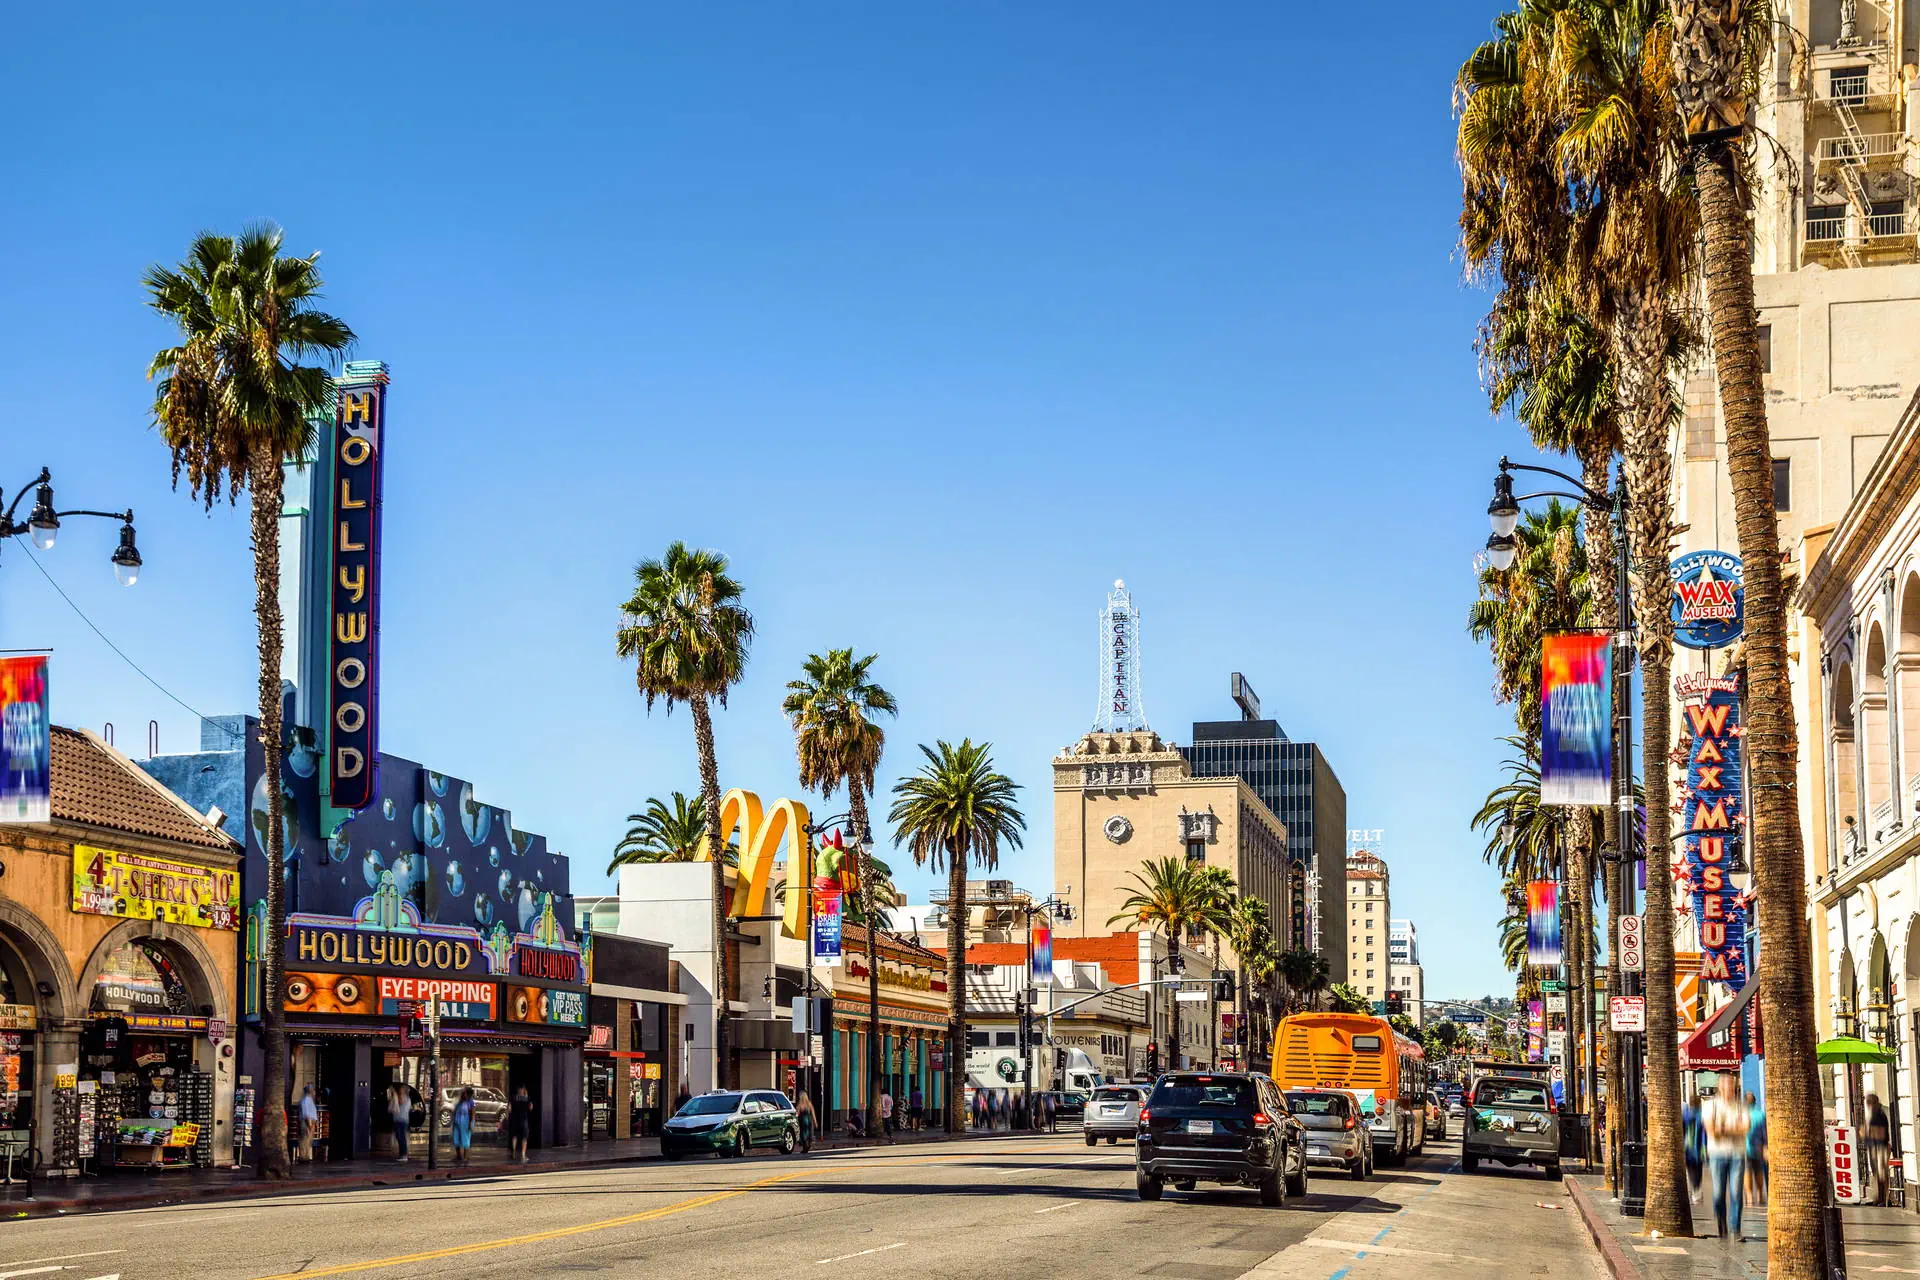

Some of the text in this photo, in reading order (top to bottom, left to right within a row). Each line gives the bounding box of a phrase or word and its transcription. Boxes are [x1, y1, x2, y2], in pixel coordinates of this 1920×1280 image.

[1670, 554, 1744, 583] OLLYWOO
[336, 392, 371, 780] HOLLYWOOD
[1678, 580, 1735, 605] WAX
[1681, 605, 1736, 620] MUSEUM
[1112, 623, 1128, 712] CAPITAN
[1676, 671, 1739, 698] Hollywood
[1686, 704, 1732, 980] WAX MUSEUM
[87, 851, 107, 885] 4
[111, 866, 200, 906] T-SHIRTS
[817, 913, 838, 923] ISRAEL
[299, 930, 471, 970] HOLLYWOOD
[521, 947, 577, 981] HOLLYWOOD
[105, 987, 161, 1004] HOLLYWOOD
[382, 978, 491, 1002] EYE POPPING
[555, 991, 581, 1002] GET YOUR
[553, 999, 583, 1015] VIP PASS
[560, 1013, 576, 1023] HERE
[210, 1021, 225, 1032] ATM
[1834, 1128, 1853, 1198] TOURS
